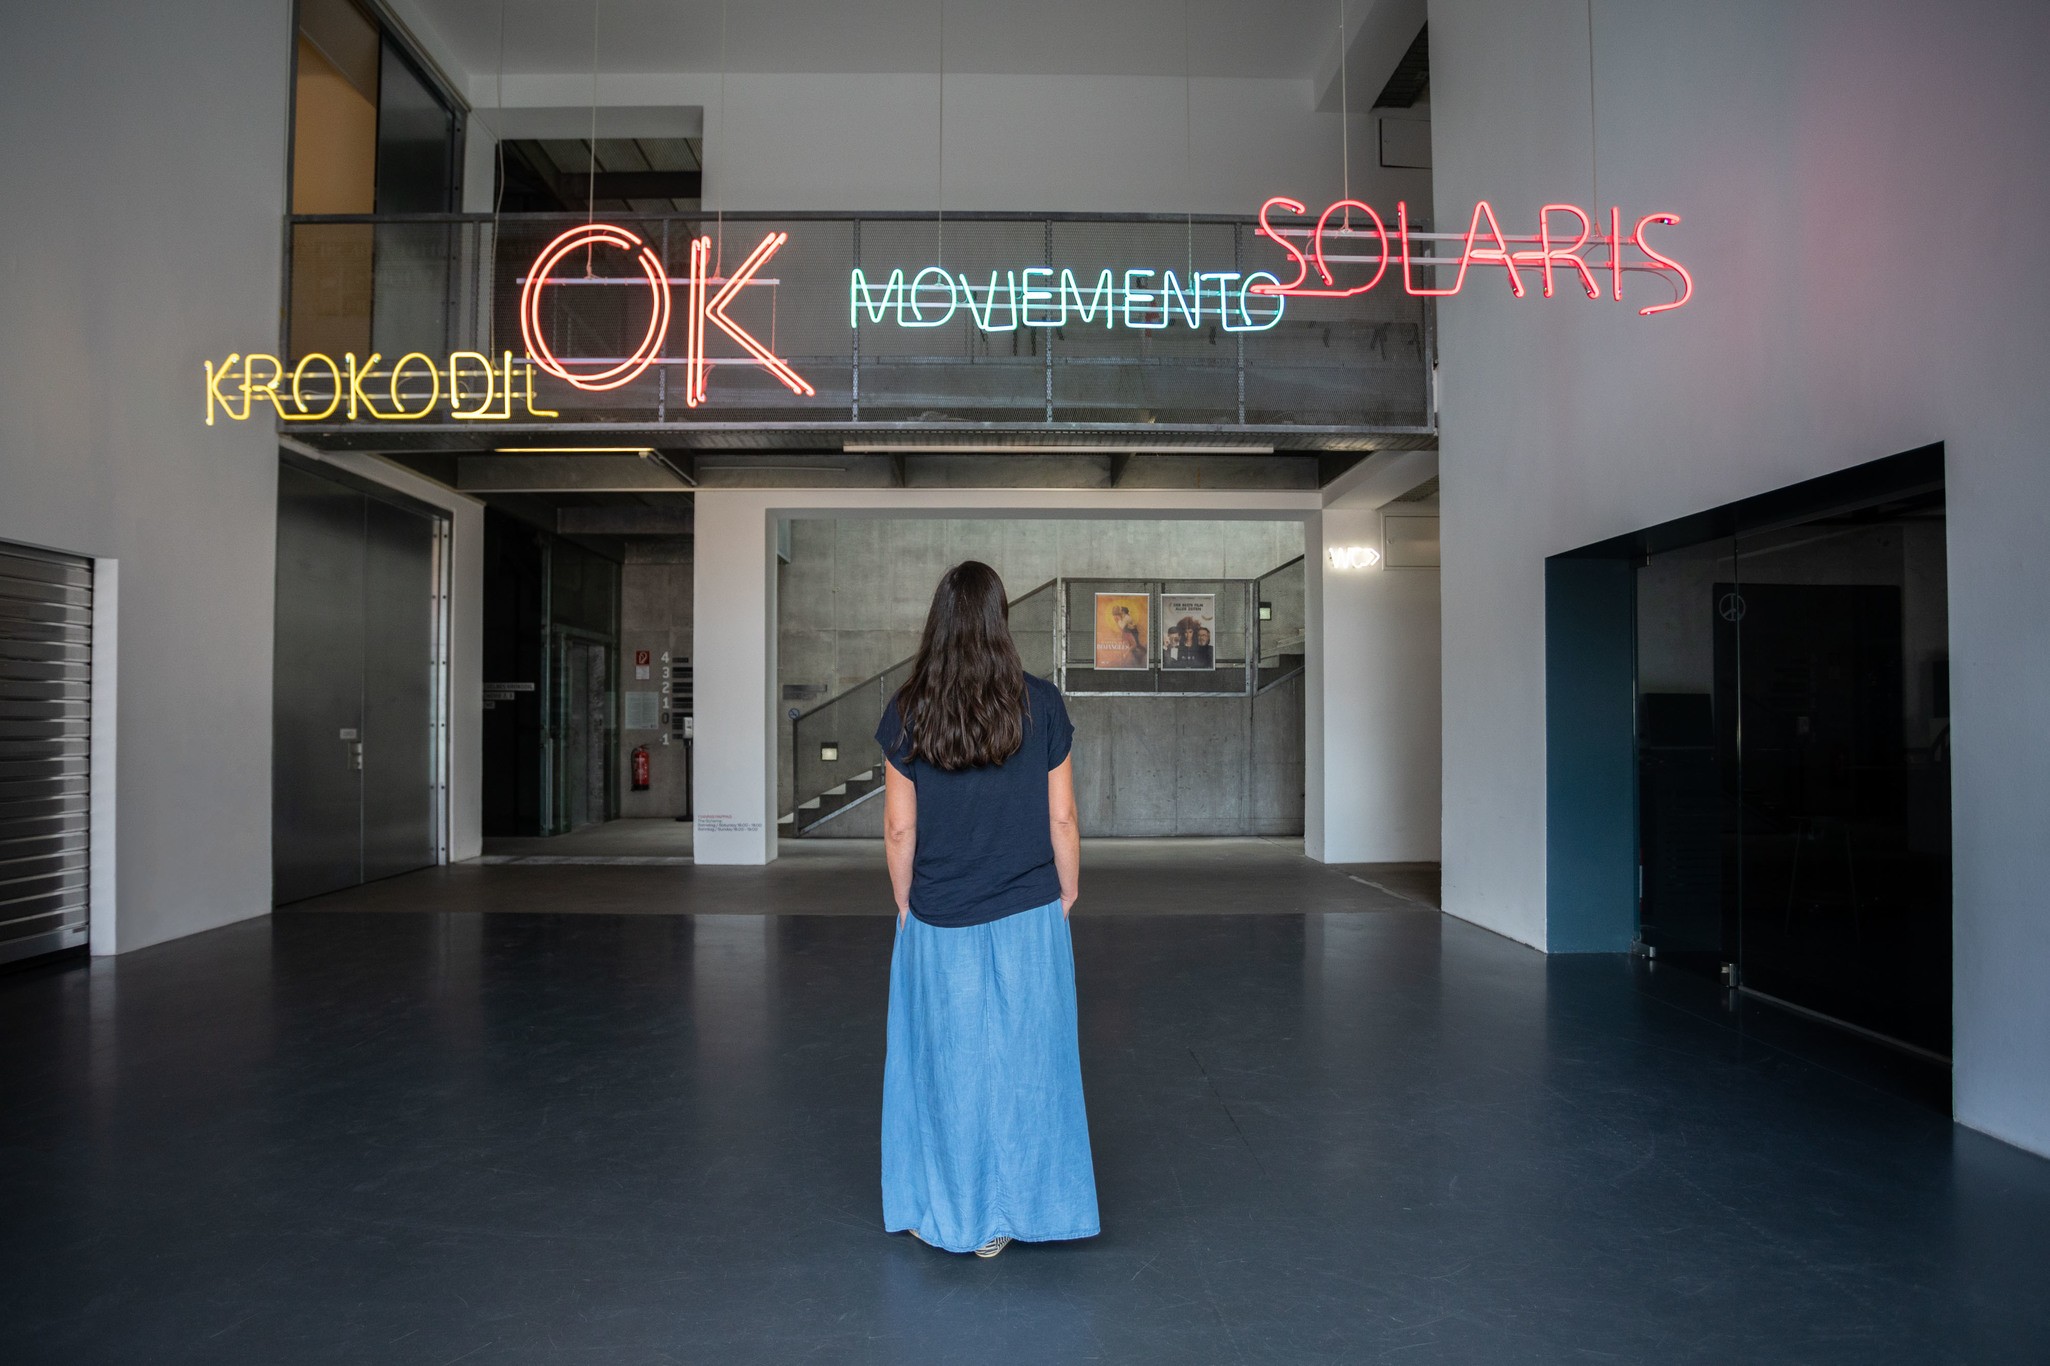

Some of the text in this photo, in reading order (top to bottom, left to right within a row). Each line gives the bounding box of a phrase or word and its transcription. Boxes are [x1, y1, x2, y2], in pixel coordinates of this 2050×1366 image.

[1249, 196, 1695, 316] SOLARIS
[849, 265, 1286, 333] MOVIEMENTO
[520, 223, 816, 408] OK
[204, 350, 559, 426] KROKODIL
[1328, 547, 1363, 569] WC
[661, 652, 670, 663] 4
[662, 667, 670, 678] 3
[662, 682, 670, 693] 2
[662, 697, 670, 709] 1
[661, 713, 670, 725] 0
